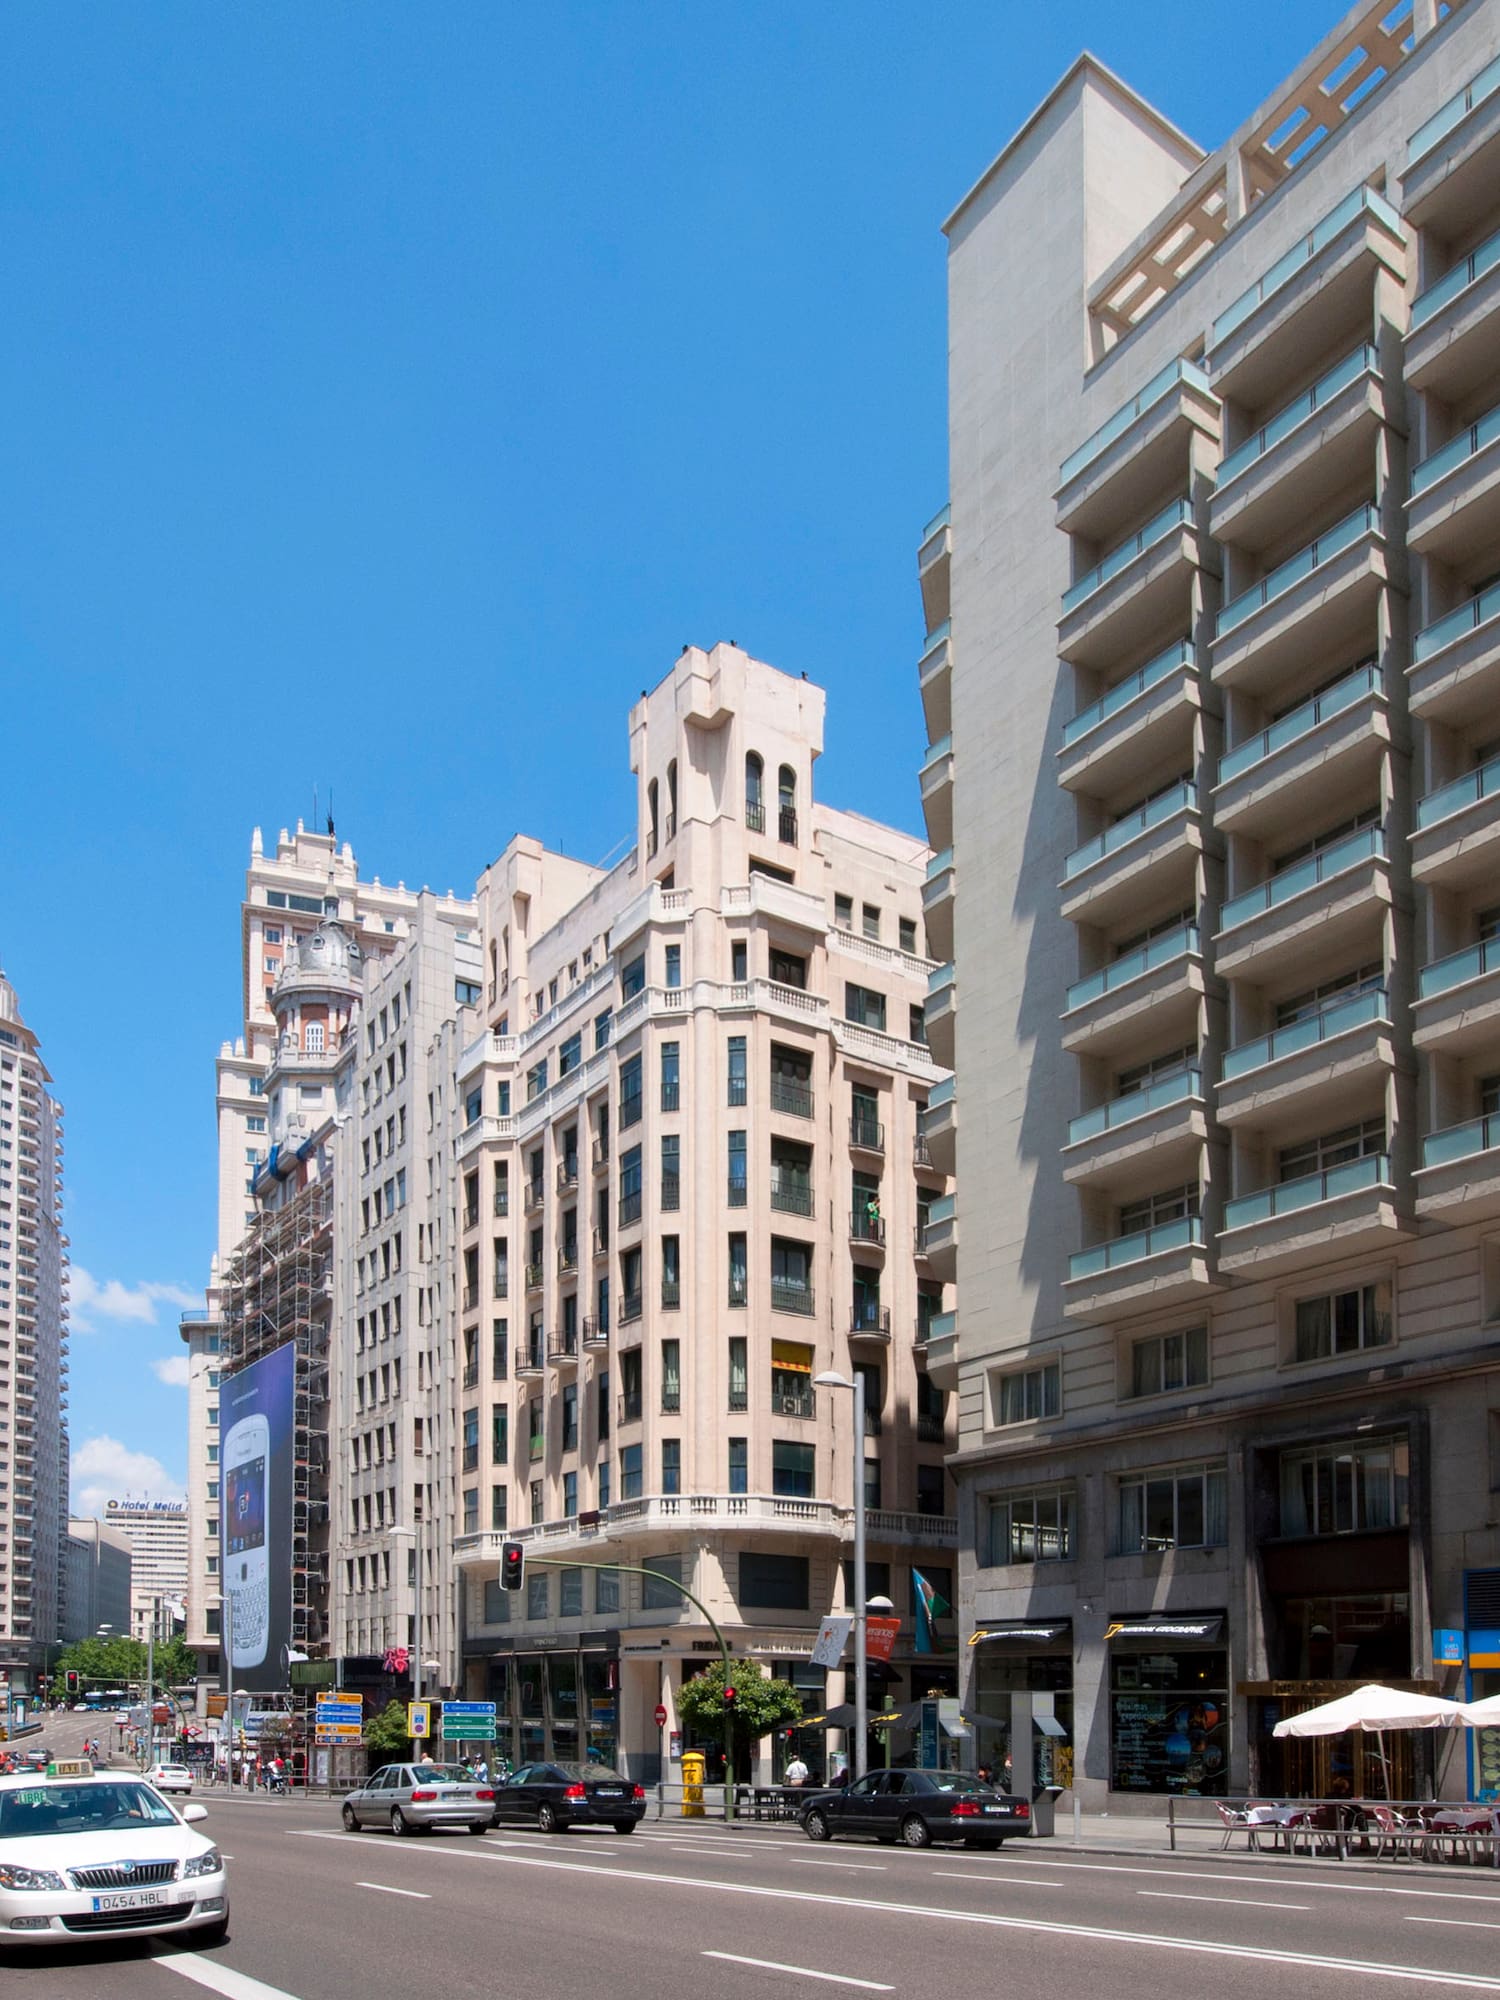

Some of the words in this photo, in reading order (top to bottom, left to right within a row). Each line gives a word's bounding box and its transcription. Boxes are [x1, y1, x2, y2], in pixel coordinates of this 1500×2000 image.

[121, 1501, 149, 1510] Hotel
[692, 1640, 733, 1652] FRIDAS
[59, 1763, 80, 1775] TAXI
[18, 1790, 47, 1805] LIBRE
[102, 1896, 136, 1910] 0454
[140, 1893, 164, 1905] HBL
